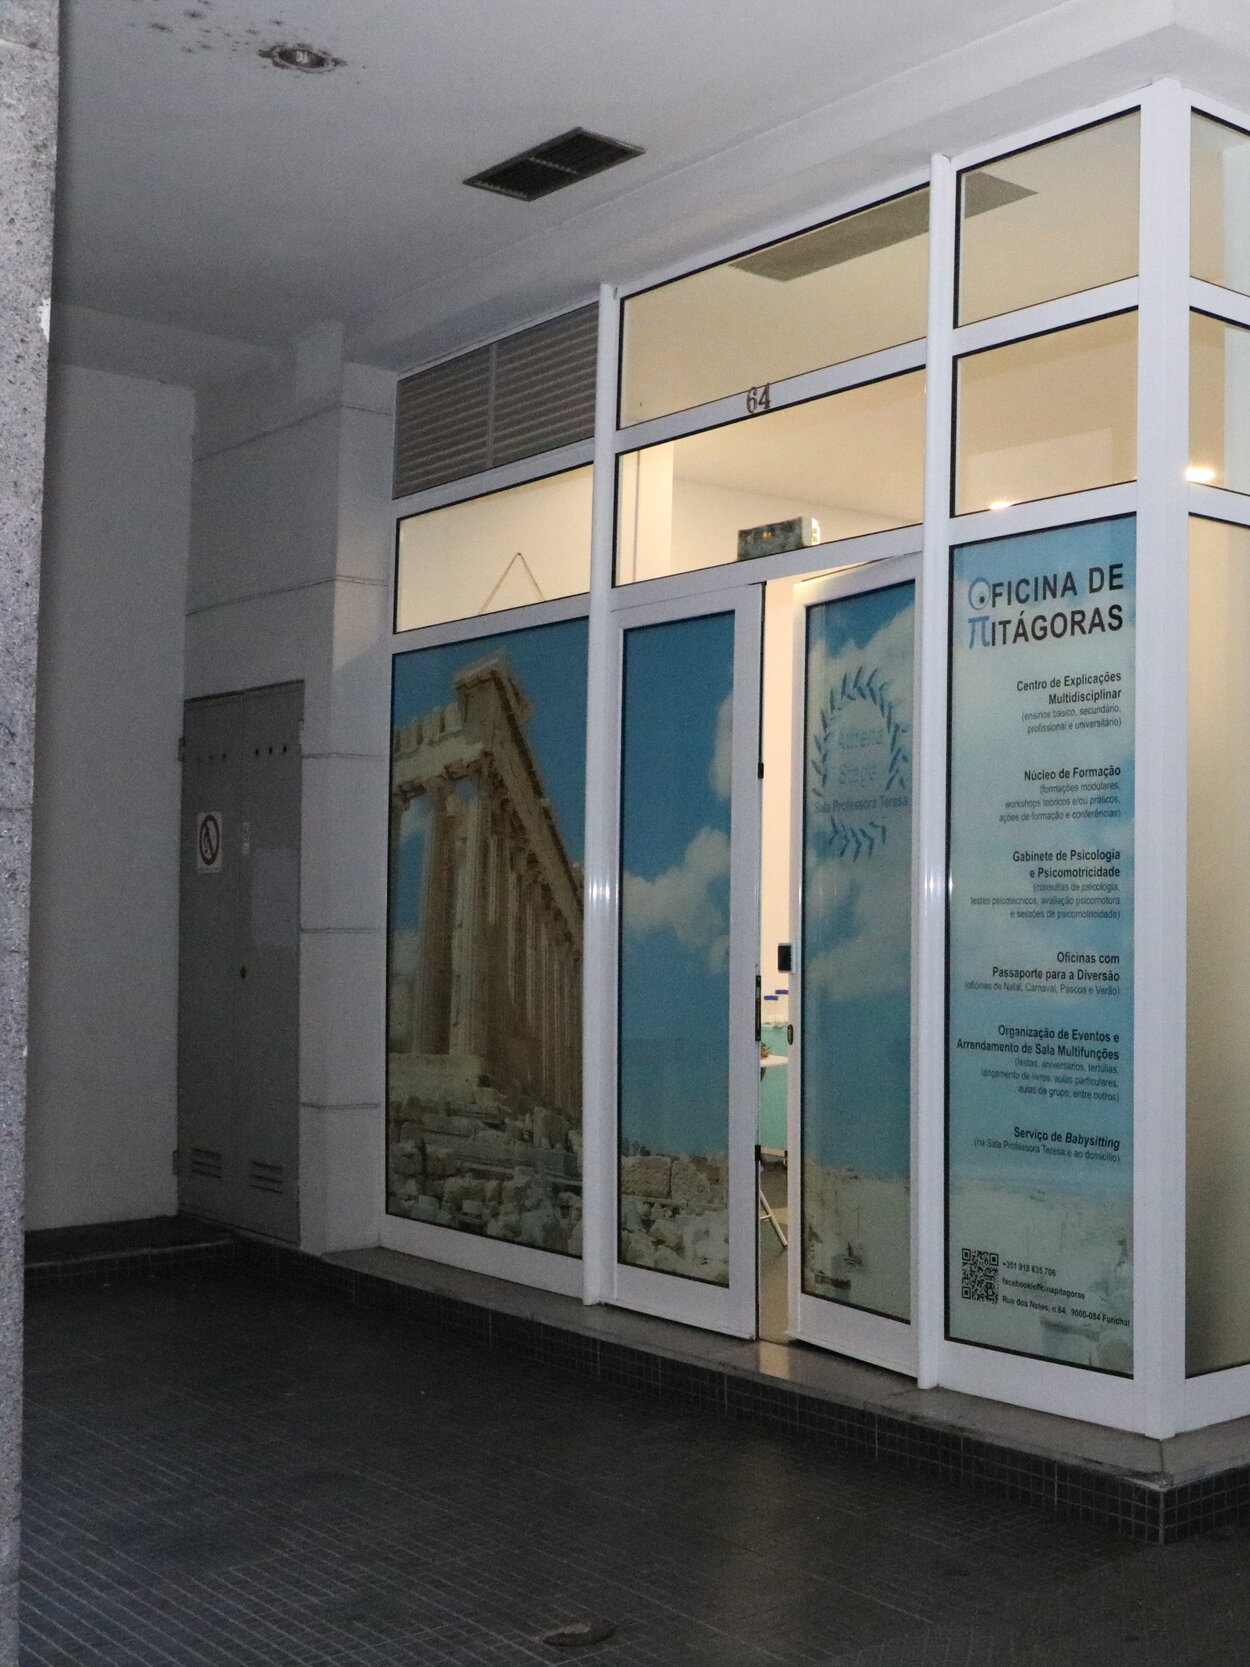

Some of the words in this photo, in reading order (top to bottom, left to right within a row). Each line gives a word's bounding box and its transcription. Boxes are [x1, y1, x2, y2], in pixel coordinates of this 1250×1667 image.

[746, 383, 771, 414] 64
[1089, 563, 1124, 594] DE
[1017, 680, 1047, 692] Centro
[1050, 677, 1061, 688] de
[1064, 672, 1122, 688] Explicações
[1049, 689, 1122, 704] Multidisciplinar
[1022, 711, 1051, 722] (ensinos
[1027, 723, 1067, 735] profissional
[1075, 717, 1121, 729] universitário)
[1024, 769, 1056, 781] Núcleo
[1059, 769, 1070, 779] de
[1073, 765, 1121, 779] Formação
[1005, 799, 1041, 809] workshops
[999, 814, 1019, 824] ações
[1021, 813, 1030, 821] de
[1032, 811, 1064, 821] formação
[1013, 851, 1053, 862] Gabinete
[1056, 850, 1067, 861] de
[1070, 849, 1120, 863] Psicologia
[1038, 866, 1120, 878] Psicomotricidade
[1034, 883, 1069, 893] (consultas
[1071, 883, 1080, 892] de
[1082, 883, 1120, 893] psicologia,
[1076, 897, 1120, 906] psicomotora
[1017, 910, 1045, 919] sessões
[1047, 909, 1055, 918] de
[1057, 952, 1096, 964] Oficinas
[1099, 955, 1120, 964] com
[992, 966, 1043, 981] Passaporte
[1045, 970, 1066, 981] para
[1069, 971, 1074, 979] a
[1078, 969, 1120, 982] Diversão
[993, 983, 1003, 991] de
[1095, 985, 1120, 997] Verão)
[998, 1025, 1055, 1040] Organização
[1058, 1029, 1069, 1040] de
[1072, 1029, 1111, 1042] Eventos
[1113, 1035, 1119, 1043] e
[957, 1038, 1019, 1053] Arrendamento
[1022, 1042, 1033, 1054] de
[1035, 1044, 1055, 1056] Sala
[1058, 1045, 1120, 1061] Multifunções
[981, 1068, 1020, 1080] lançamento
[1022, 1070, 1031, 1080] de
[1054, 1073, 1073, 1084] aulas
[1018, 1085, 1036, 1095] aulas
[1038, 1087, 1047, 1095] de
[1073, 1089, 1092, 1099] entre
[1094, 1090, 1120, 1102] outros)
[1014, 1126, 1048, 1141] Serviço
[1051, 1131, 1062, 1143] de
[1065, 1132, 1120, 1151] Babysitting
[987, 1138, 1001, 1149] Sala
[1003, 1140, 1040, 1153] Professora
[1042, 1145, 1066, 1156] Teresa
[1067, 1149, 1072, 1157] e
[1074, 1150, 1083, 1158] ao
[1002, 1261, 1017, 1269] +351
[1018, 1262, 1030, 1271] 918
[1032, 1264, 1043, 1274] 635
[1002, 1296, 1015, 1305] Rua
[1017, 1298, 1029, 1307] dos
[1102, 1314, 1130, 1327] Funchal
